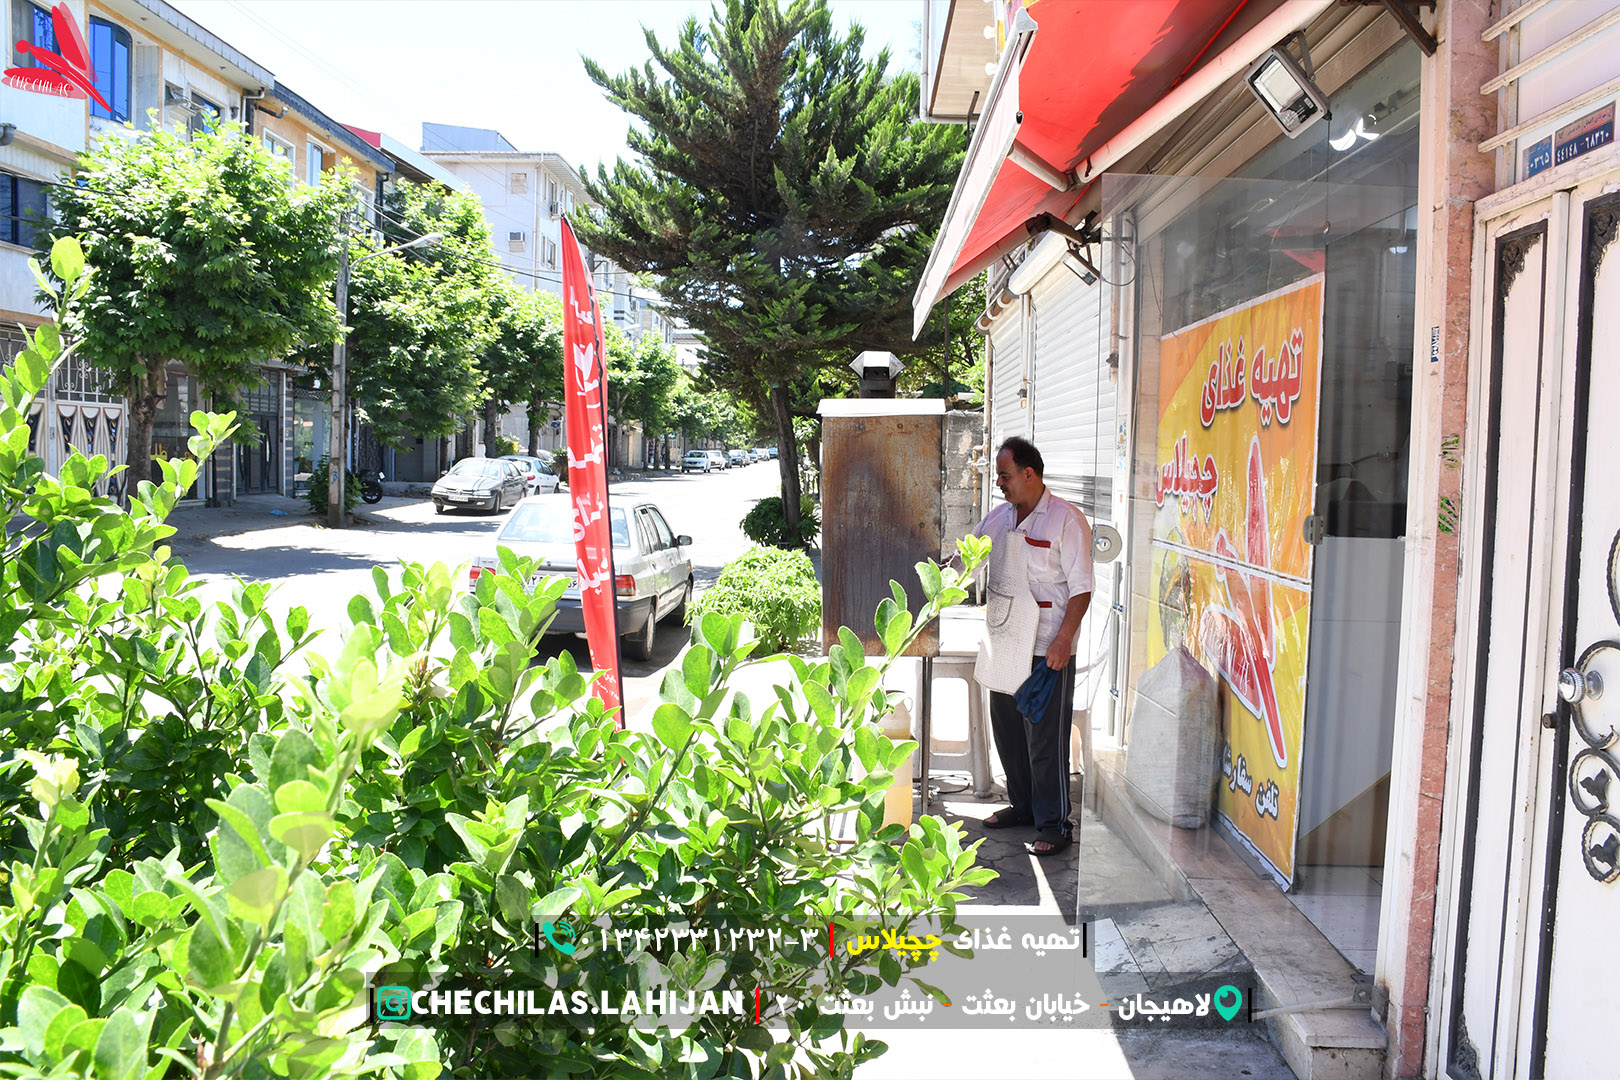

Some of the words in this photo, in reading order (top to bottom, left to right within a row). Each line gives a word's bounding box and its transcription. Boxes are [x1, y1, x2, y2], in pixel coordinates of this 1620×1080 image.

[1201, 335, 1247, 427] غذای
[1251, 327, 1304, 426] تهیه
[1156, 434, 1219, 523] چچیلاس
[1222, 741, 1252, 797] سفارشا
[1255, 778, 1280, 821] تلفن
